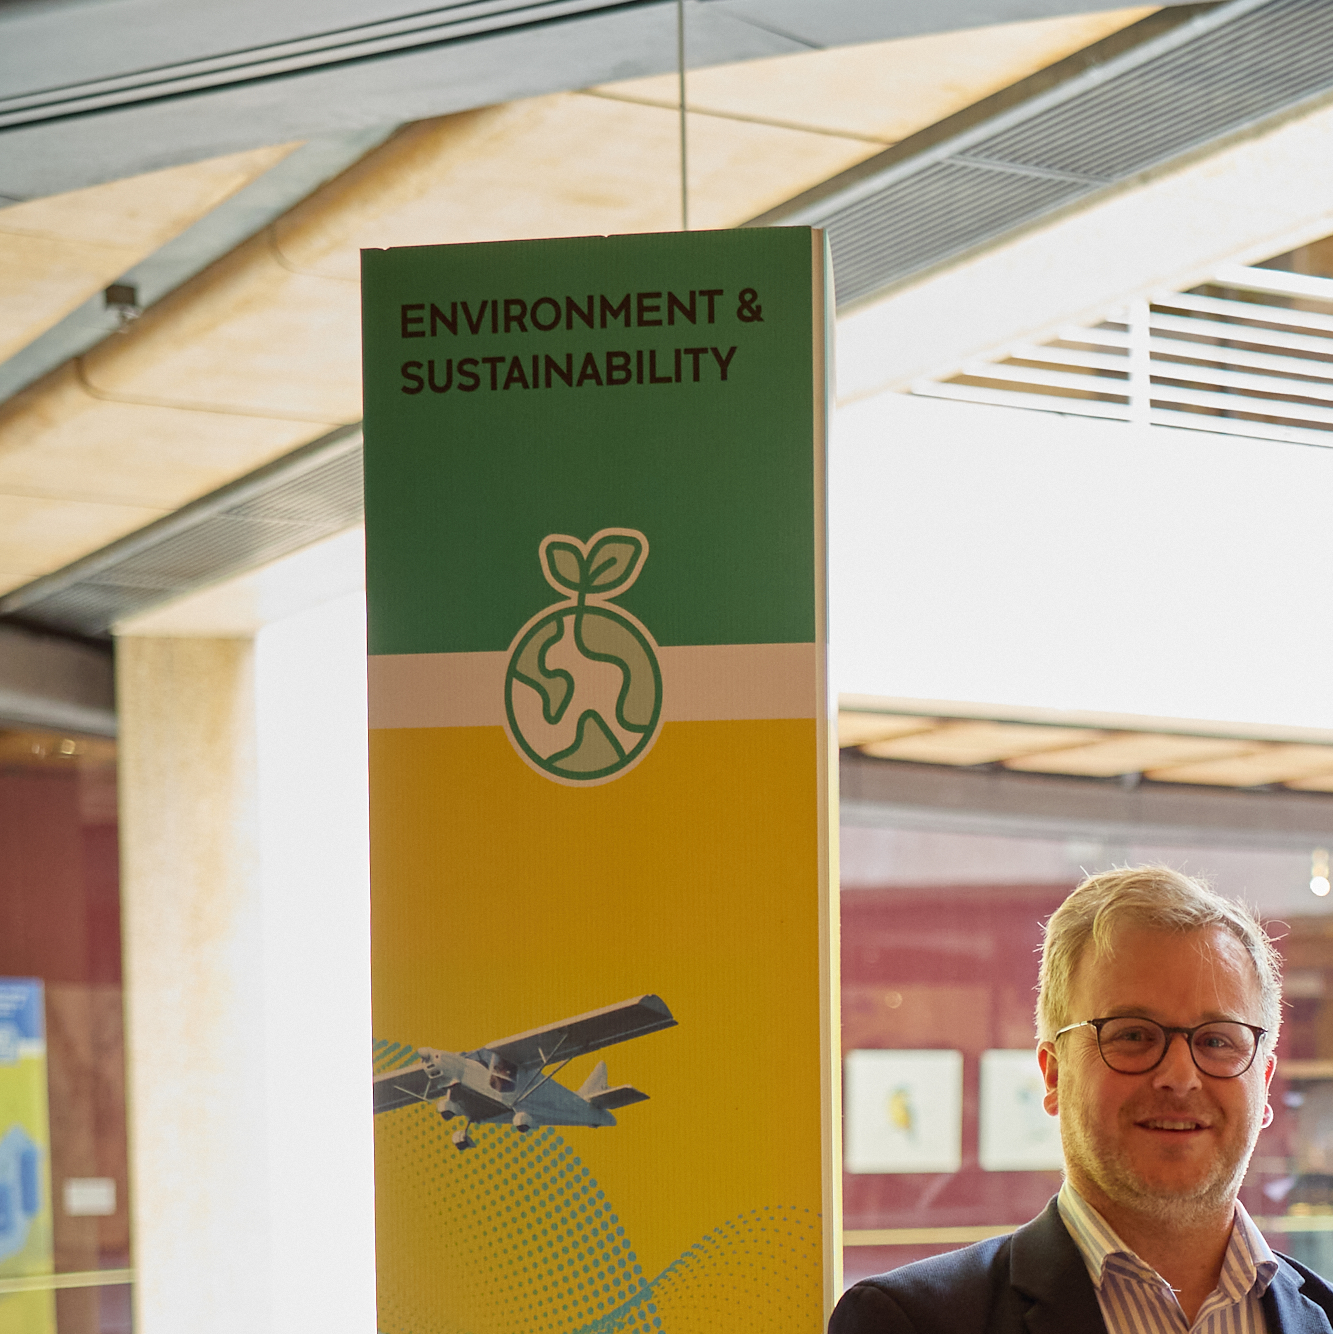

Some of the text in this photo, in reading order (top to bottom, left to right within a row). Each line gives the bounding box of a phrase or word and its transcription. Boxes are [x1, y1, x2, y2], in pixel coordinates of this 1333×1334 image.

[400, 288, 765, 339] ENVIRONMENT &
[400, 346, 738, 395] SUSTAINABILITY
